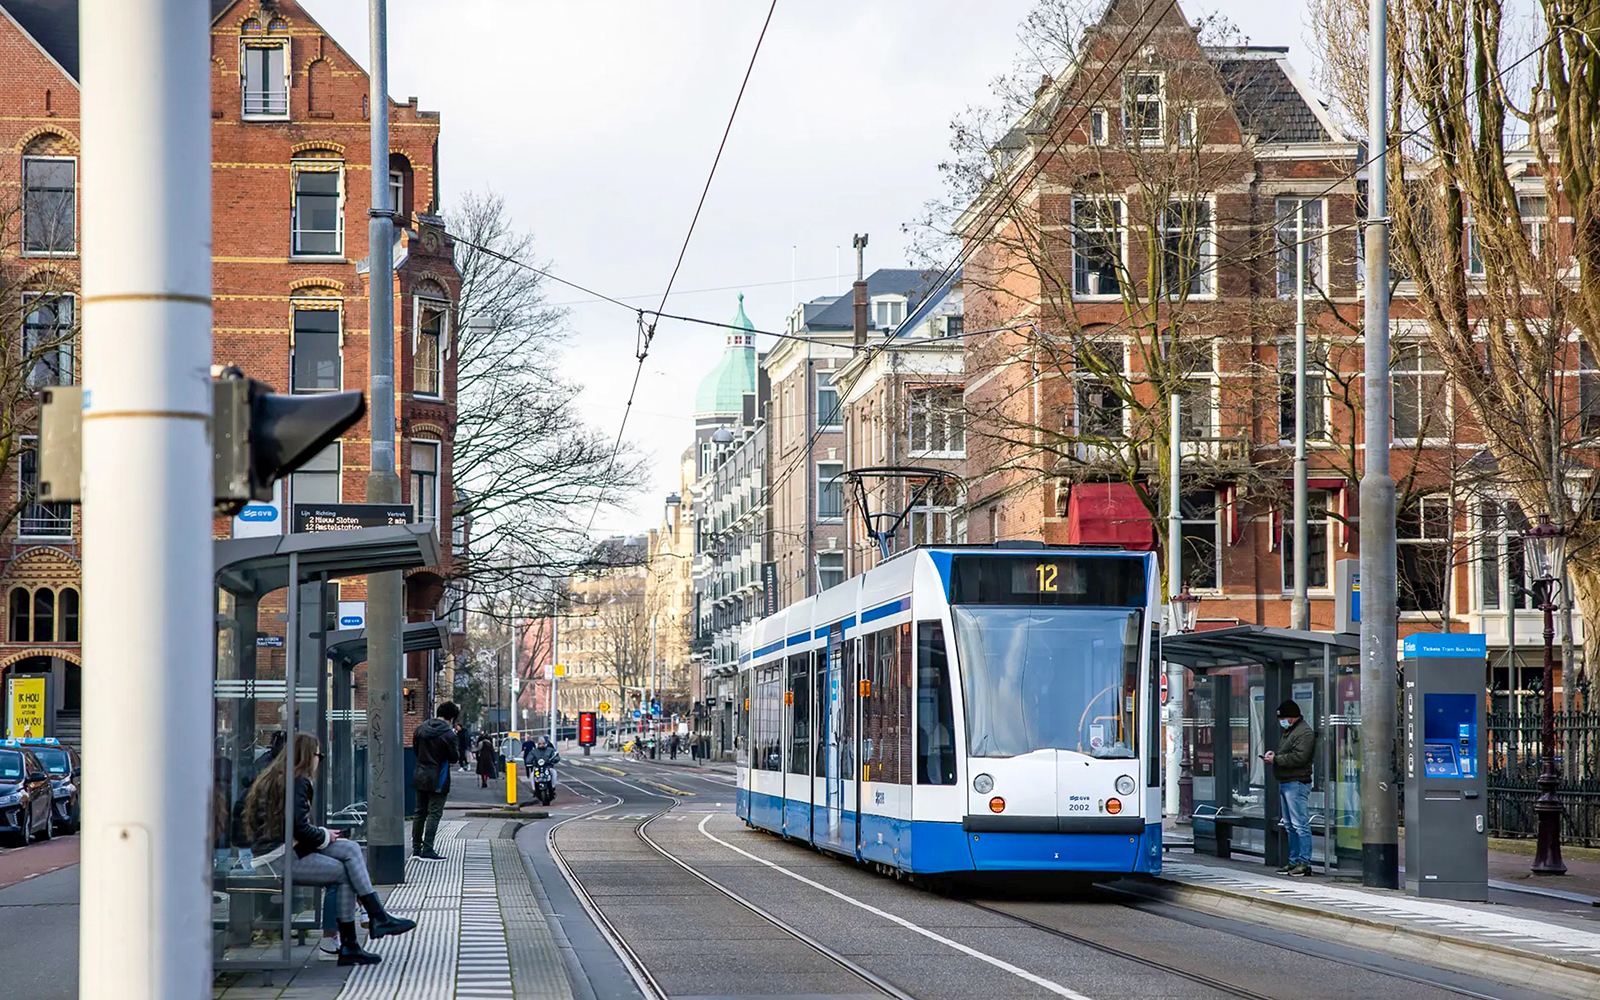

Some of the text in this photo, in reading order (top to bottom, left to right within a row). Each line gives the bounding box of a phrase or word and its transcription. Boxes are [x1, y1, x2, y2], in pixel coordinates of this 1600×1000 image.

[1036, 564, 1057, 591] 12
[18, 694, 39, 702] IK HOU
[16, 717, 41, 725] VAN JOU
